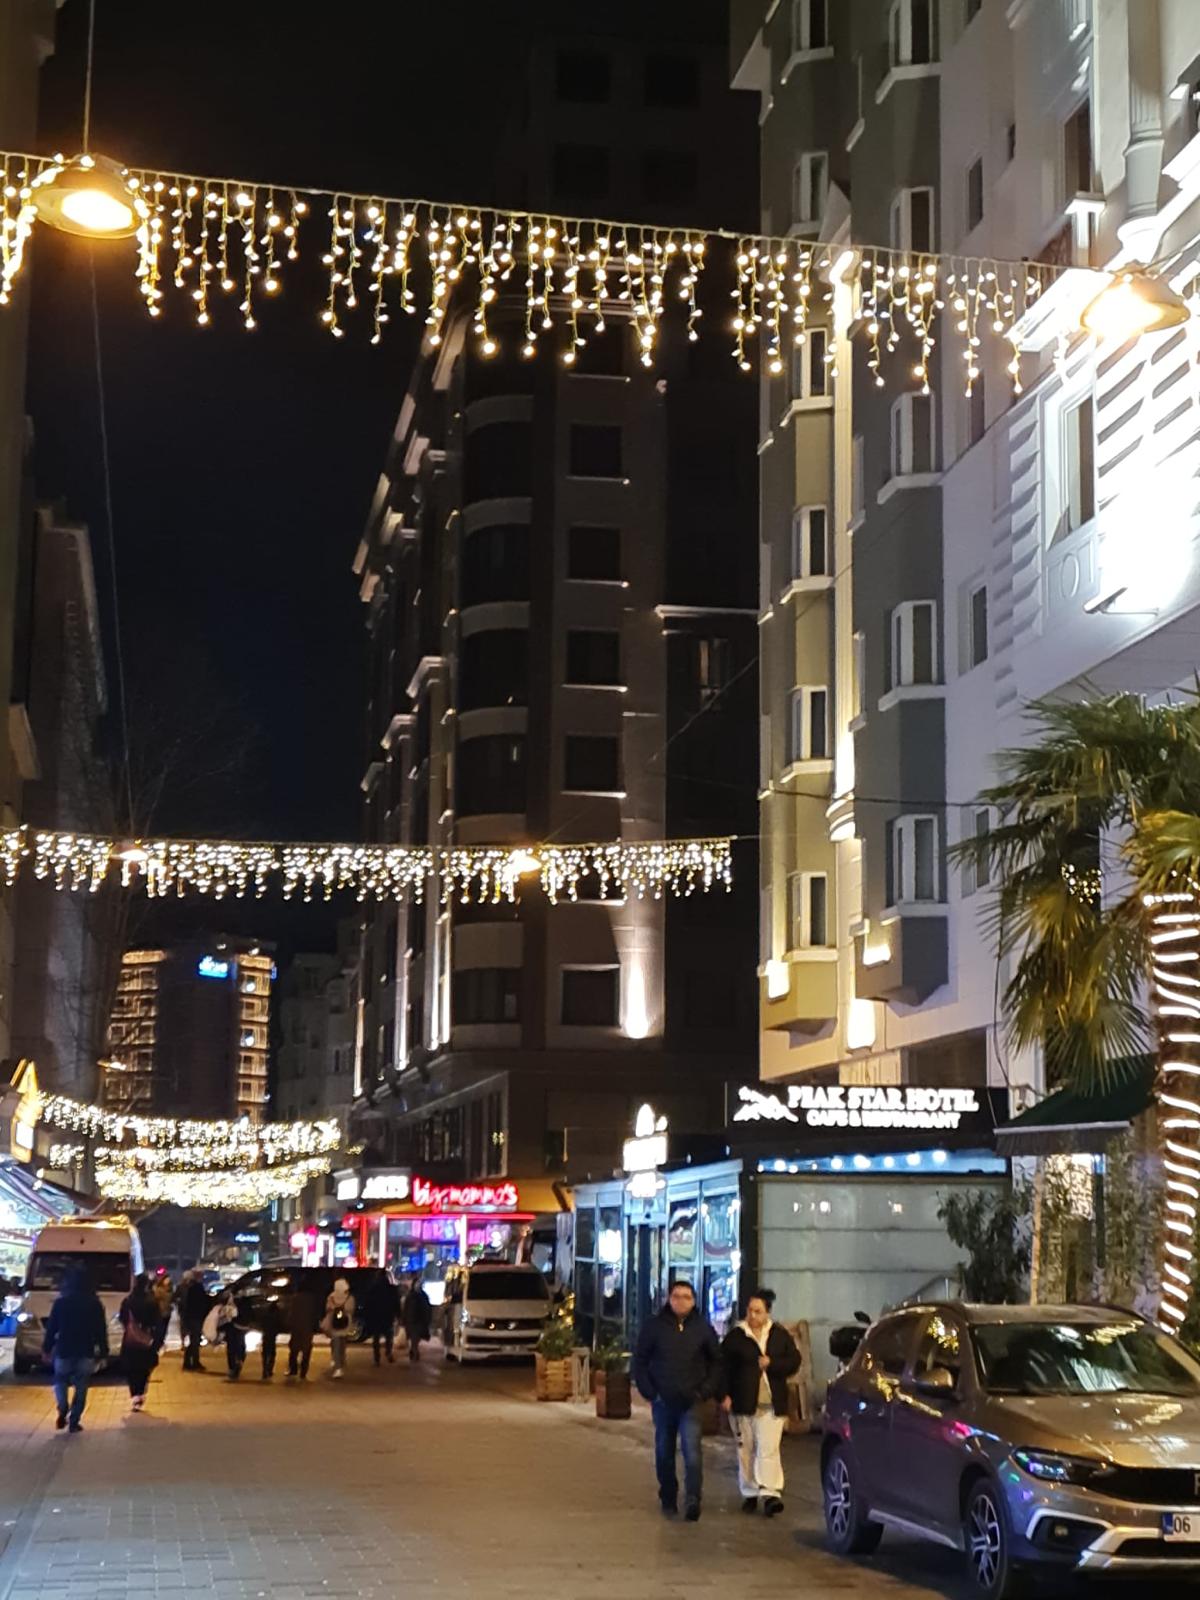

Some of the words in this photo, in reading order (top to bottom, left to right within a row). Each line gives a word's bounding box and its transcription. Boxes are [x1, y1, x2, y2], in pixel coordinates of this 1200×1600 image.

[788, 1086, 845, 1108] PEAK
[847, 1087, 905, 1109] STAR
[906, 1088, 978, 1111] HOTEL
[807, 1110, 847, 1126] CAFE
[1174, 1515, 1191, 1533] 06
